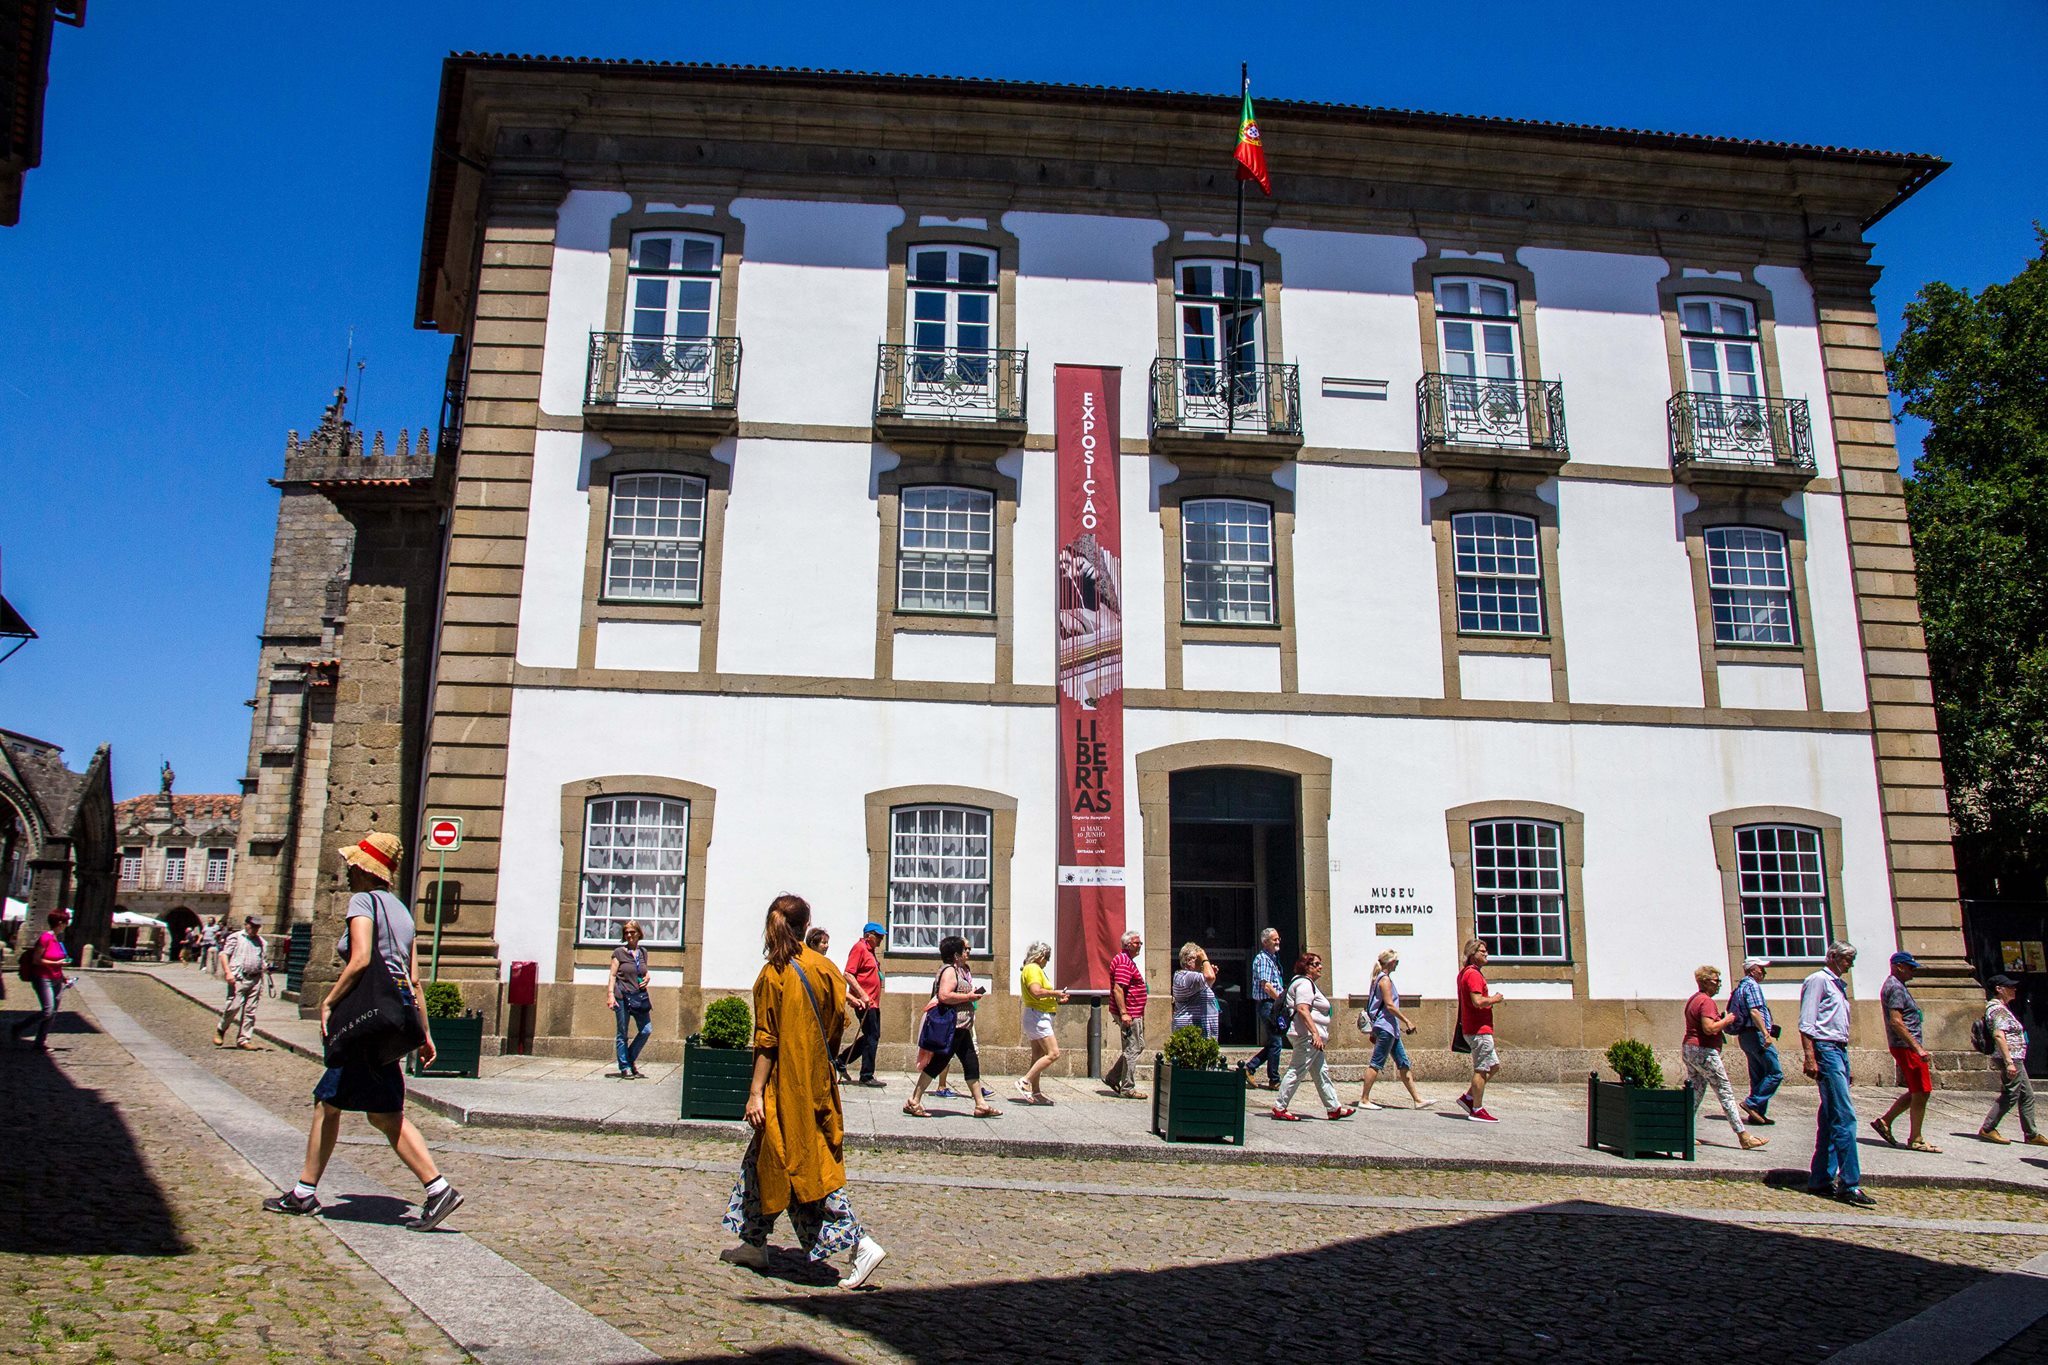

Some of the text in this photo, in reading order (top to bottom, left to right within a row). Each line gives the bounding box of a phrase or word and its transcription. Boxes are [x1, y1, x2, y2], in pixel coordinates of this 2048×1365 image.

[1081, 392, 1097, 529] EXPOSIÇÃO
[1084, 831, 1106, 839] JUNHO
[1371, 887, 1415, 898] MUSEU
[1353, 904, 1434, 914] ALBERTO SAMPAIO
[355, 1008, 379, 1025] KNOT
